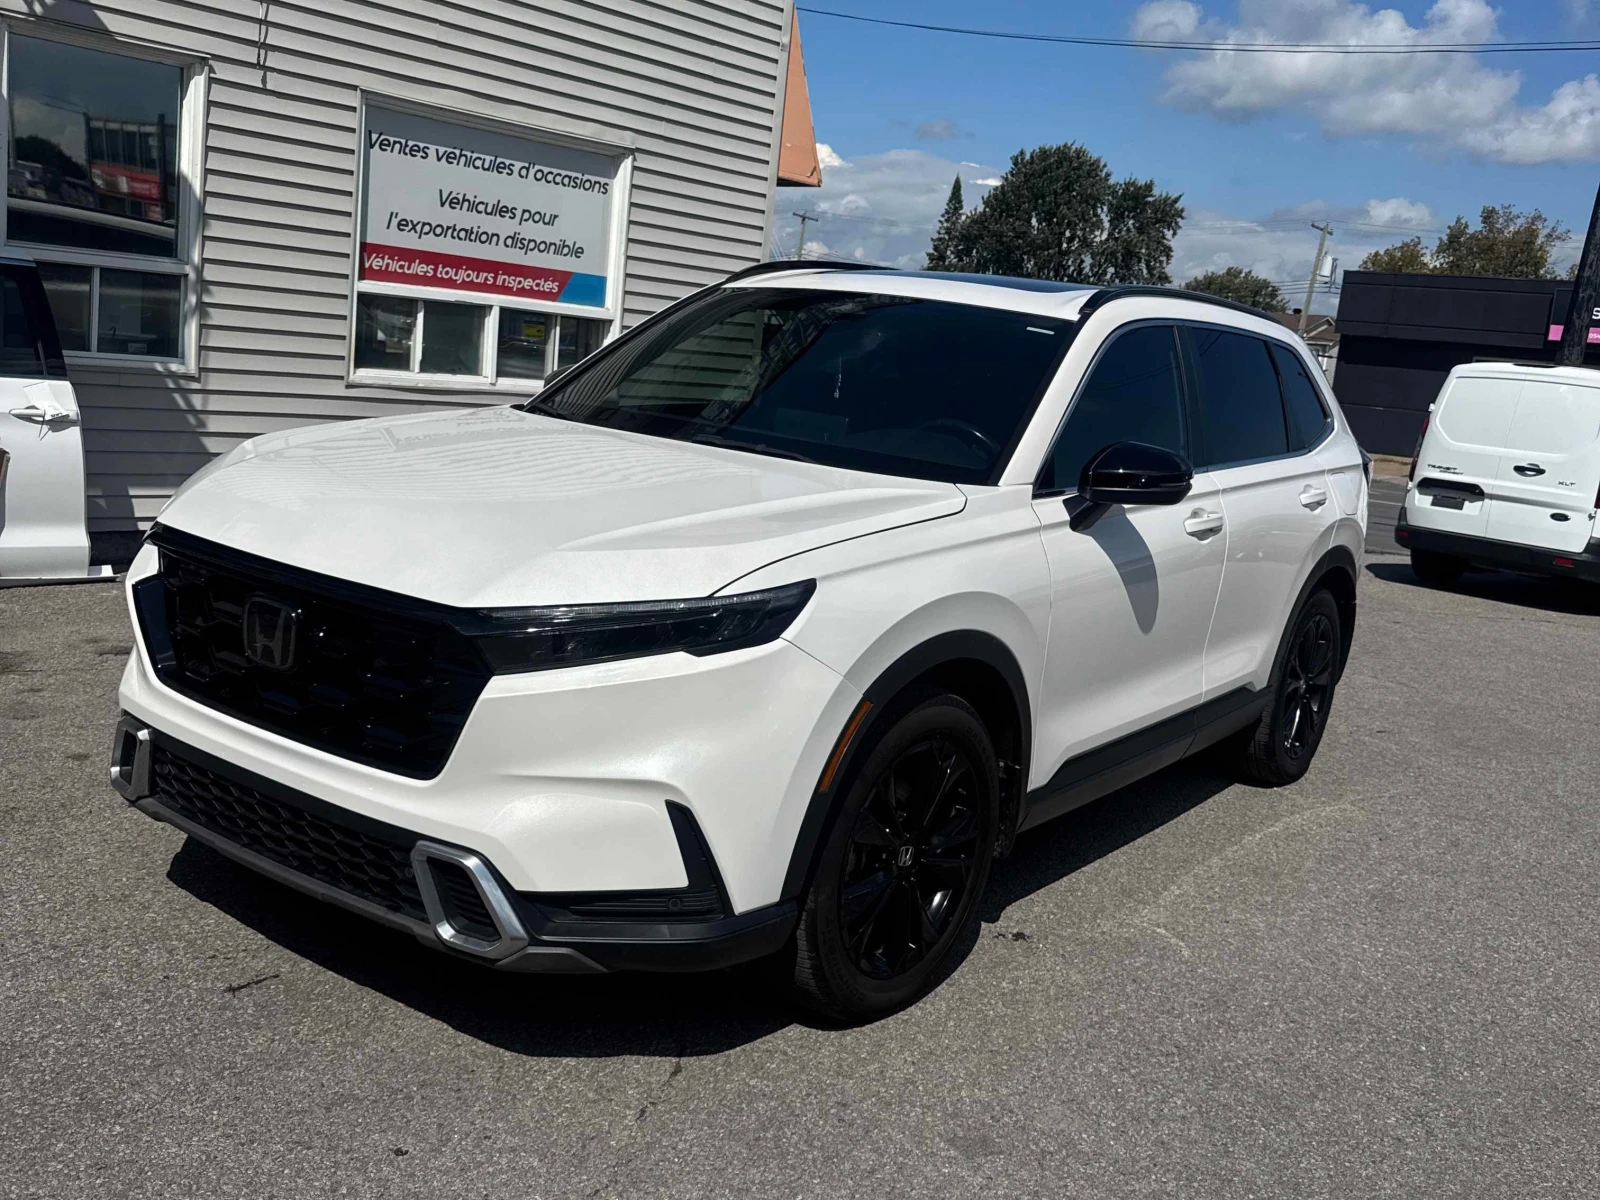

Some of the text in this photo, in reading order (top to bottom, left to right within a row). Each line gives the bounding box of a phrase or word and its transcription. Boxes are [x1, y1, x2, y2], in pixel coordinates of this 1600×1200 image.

[368, 129, 609, 195] Ventes véhicules d'occasions
[439, 188, 559, 227] Véhicules pour
[386, 211, 585, 259] l'exportation disponible
[363, 251, 559, 293] Véhicules toujours inspectés
